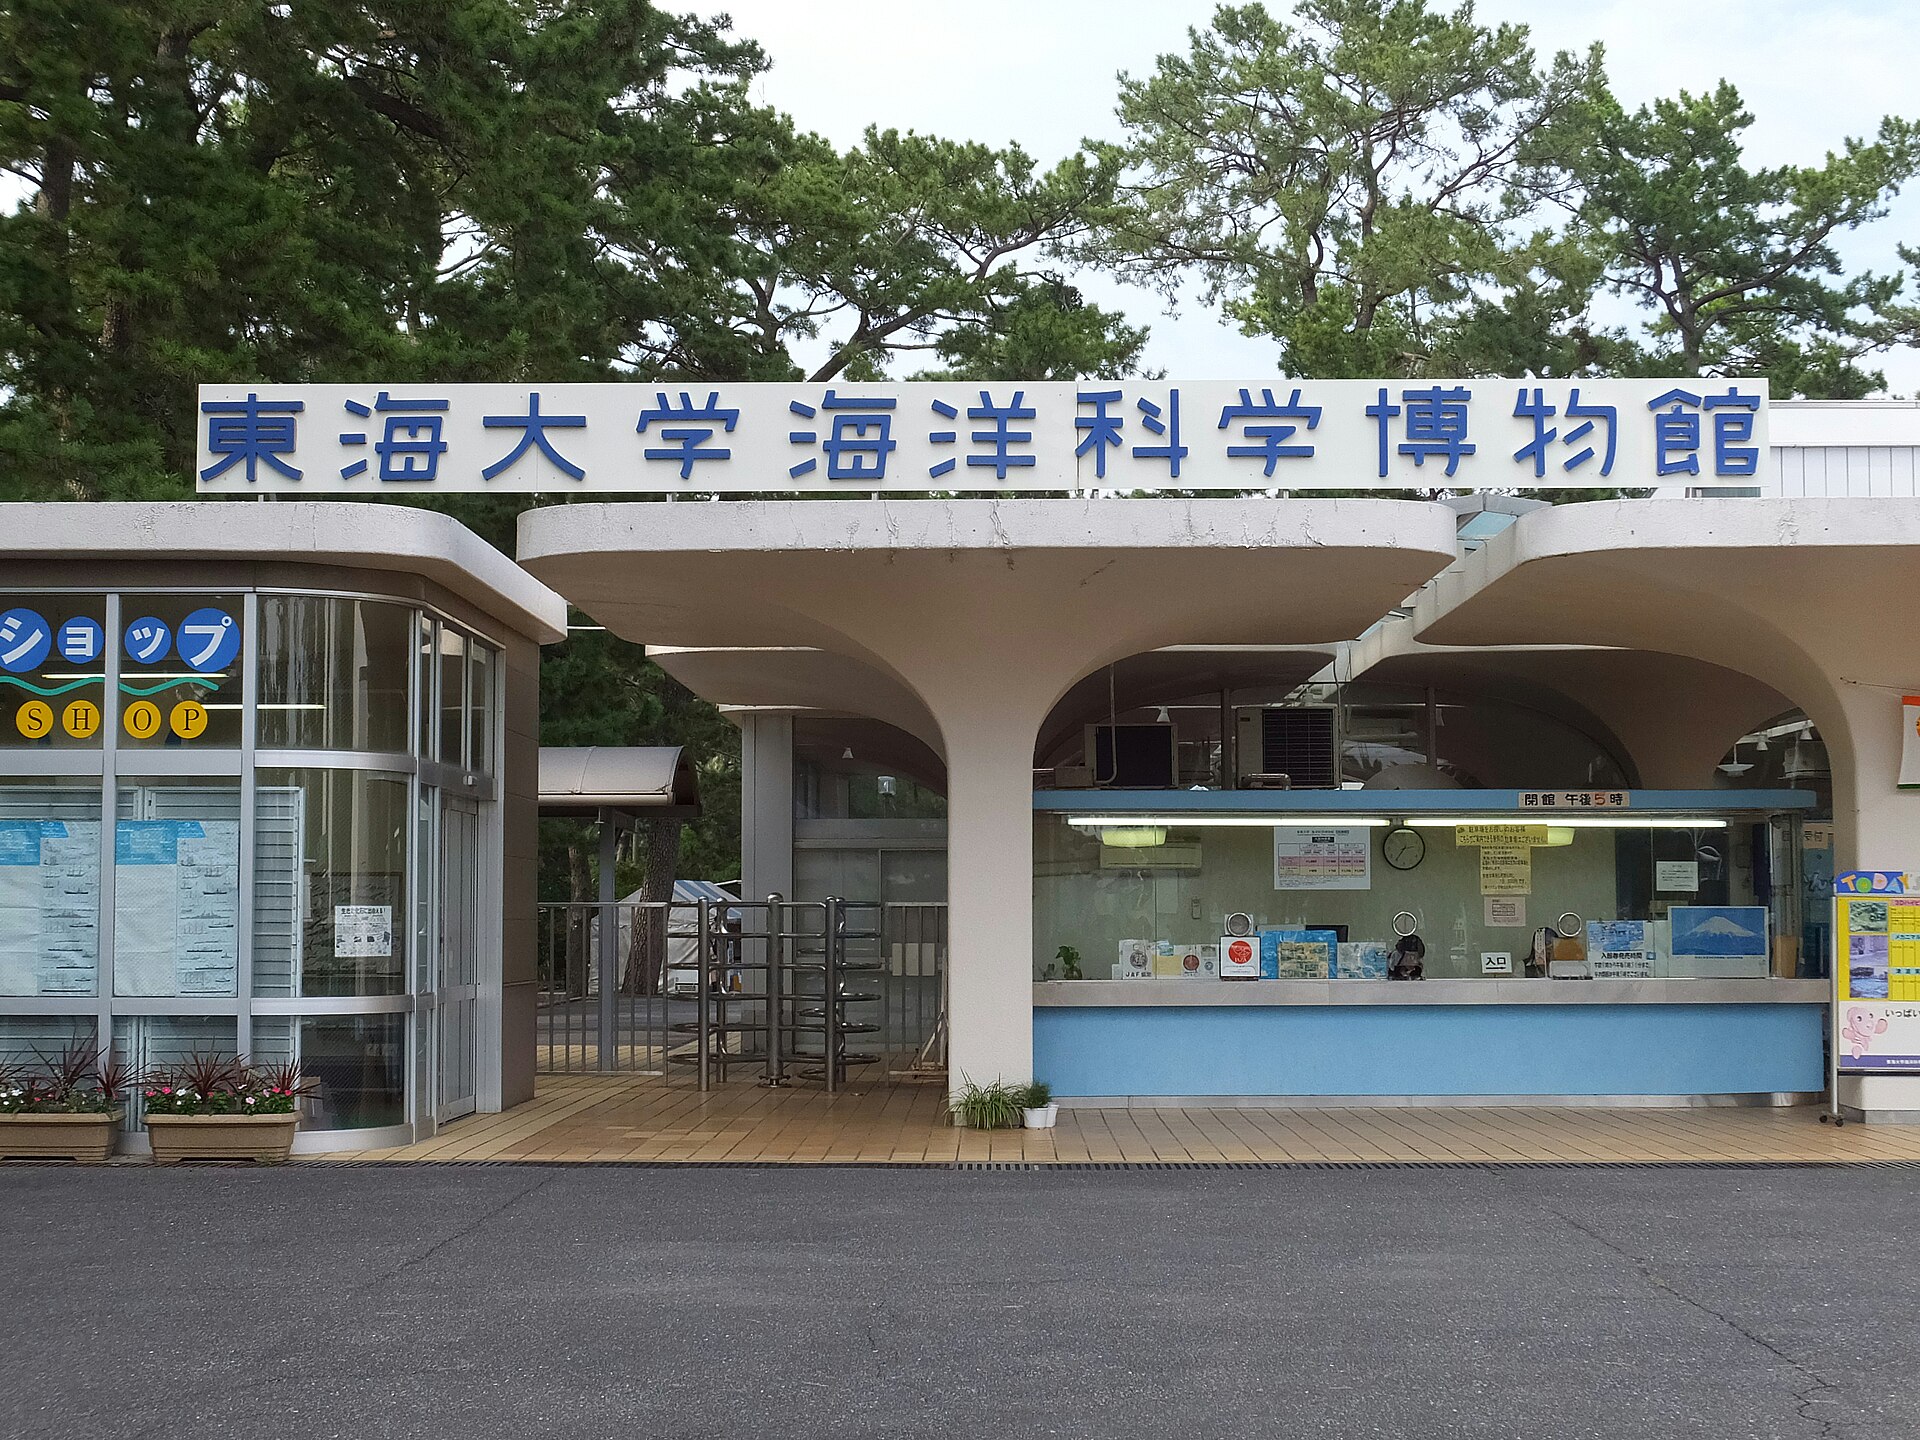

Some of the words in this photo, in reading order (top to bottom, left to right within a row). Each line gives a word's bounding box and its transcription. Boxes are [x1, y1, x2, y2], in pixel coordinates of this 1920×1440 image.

[201, 386, 1760, 482] 東海大学海洋科学博物館
[0, 616, 232, 667] ショップ
[27, 708, 200, 731] SHOP
[1565, 793, 1623, 806] 午後5時
[1485, 957, 1506, 966] 入口
